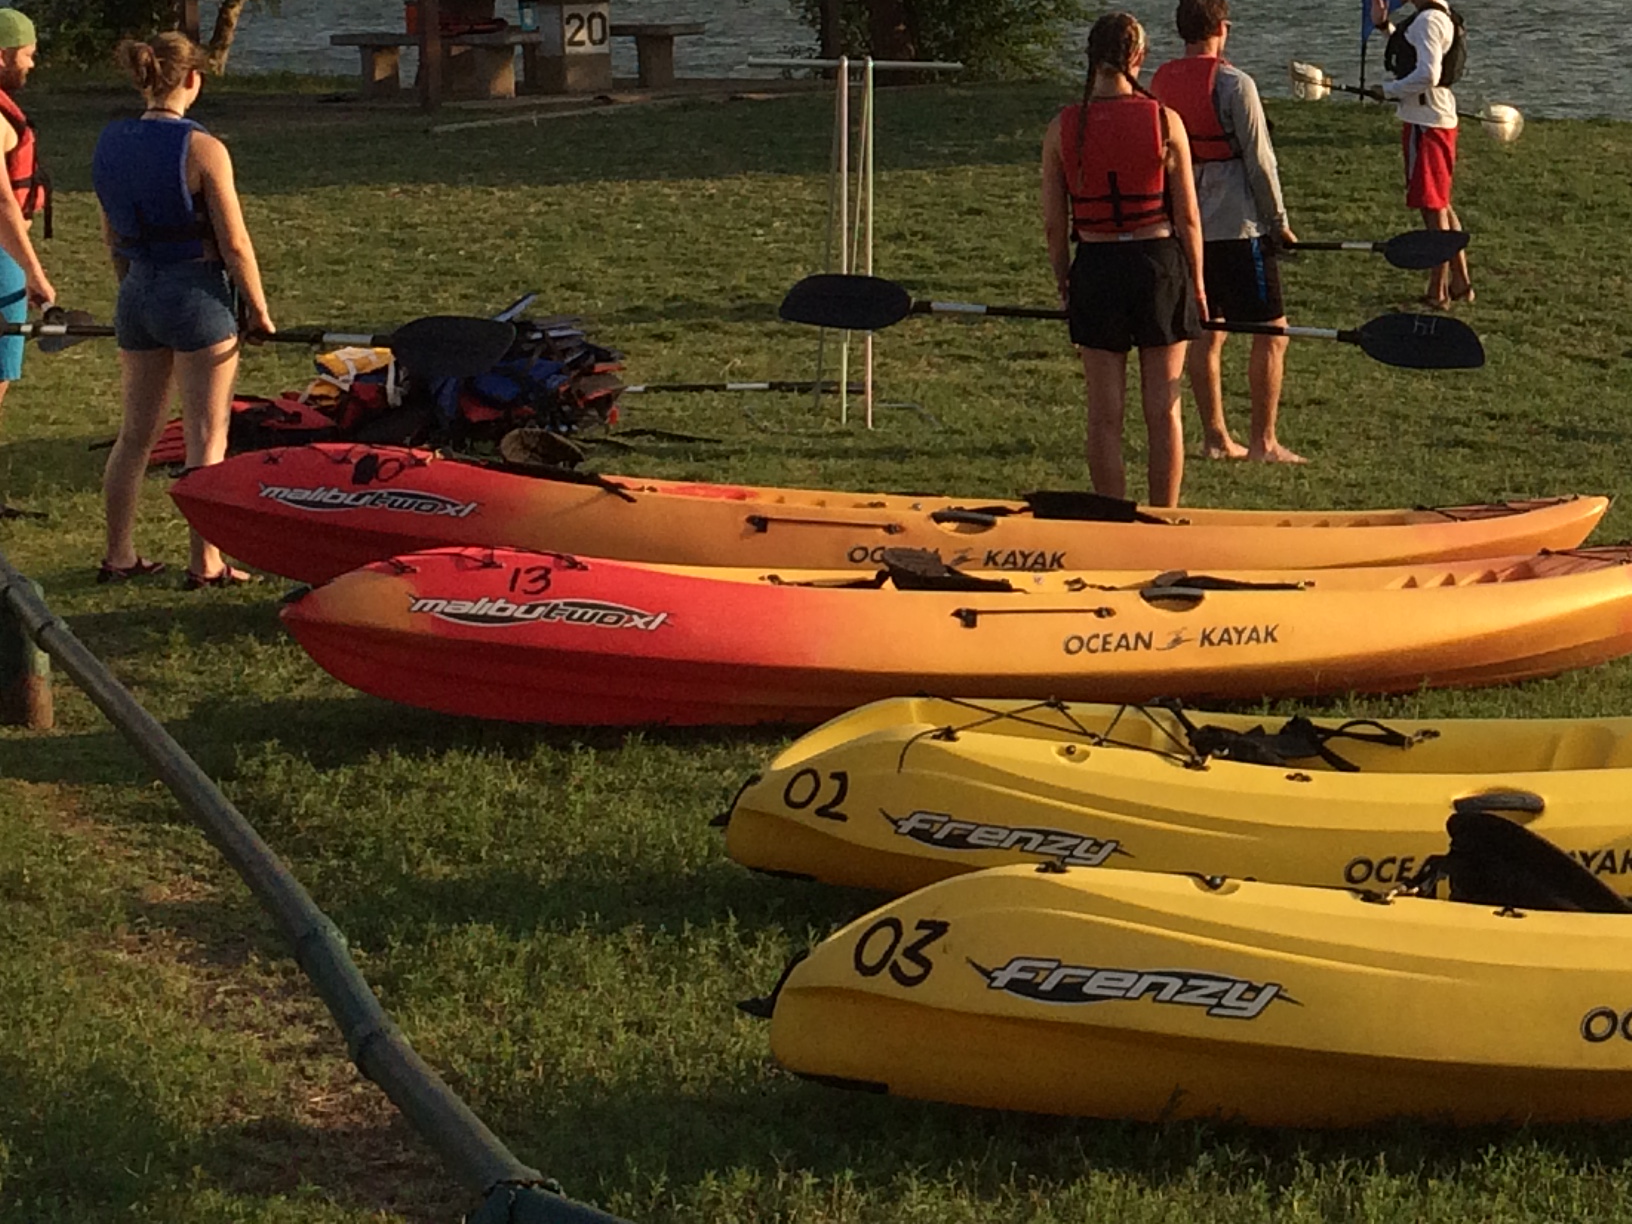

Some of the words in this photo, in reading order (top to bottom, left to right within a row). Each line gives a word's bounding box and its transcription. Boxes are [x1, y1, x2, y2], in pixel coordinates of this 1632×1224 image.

[565, 11, 607, 46] 20
[983, 549, 1067, 569] KAYAK
[508, 567, 552, 594] 13
[1064, 631, 1154, 655] OCEAN
[1199, 625, 1278, 647] KAYAK
[783, 768, 849, 821] 02
[1344, 856, 1420, 884] OCE
[854, 917, 950, 987] 03
